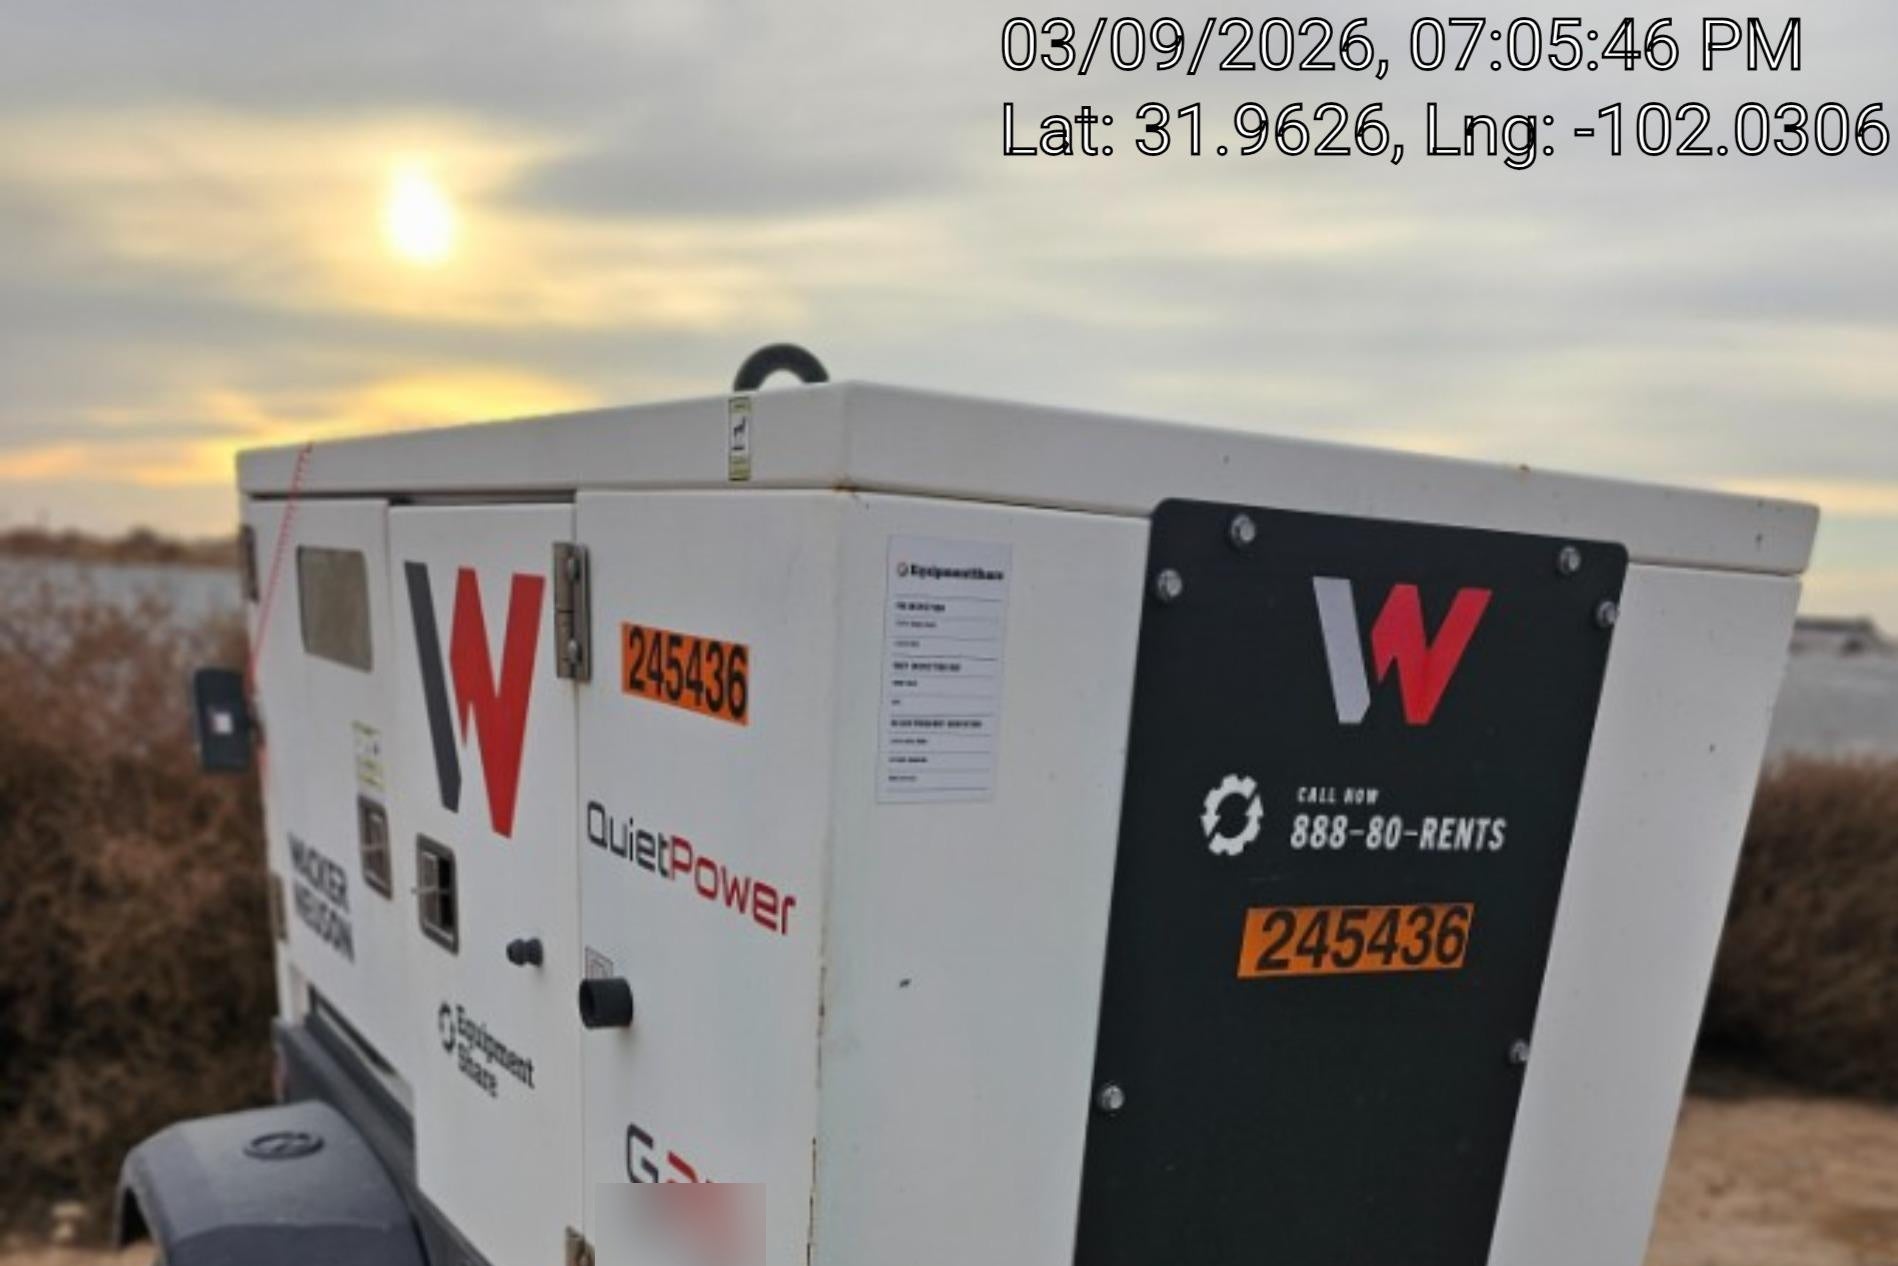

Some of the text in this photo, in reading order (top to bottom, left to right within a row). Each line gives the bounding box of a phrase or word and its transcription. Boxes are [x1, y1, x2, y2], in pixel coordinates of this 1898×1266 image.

[628, 625, 749, 720] 245436
[1290, 814, 1507, 851] 888-80-RENTS
[1297, 787, 1379, 804] CALL NOW
[587, 800, 796, 935] QuietPower
[1255, 904, 1469, 971] 245436
[456, 1004, 535, 1089] Equipment
